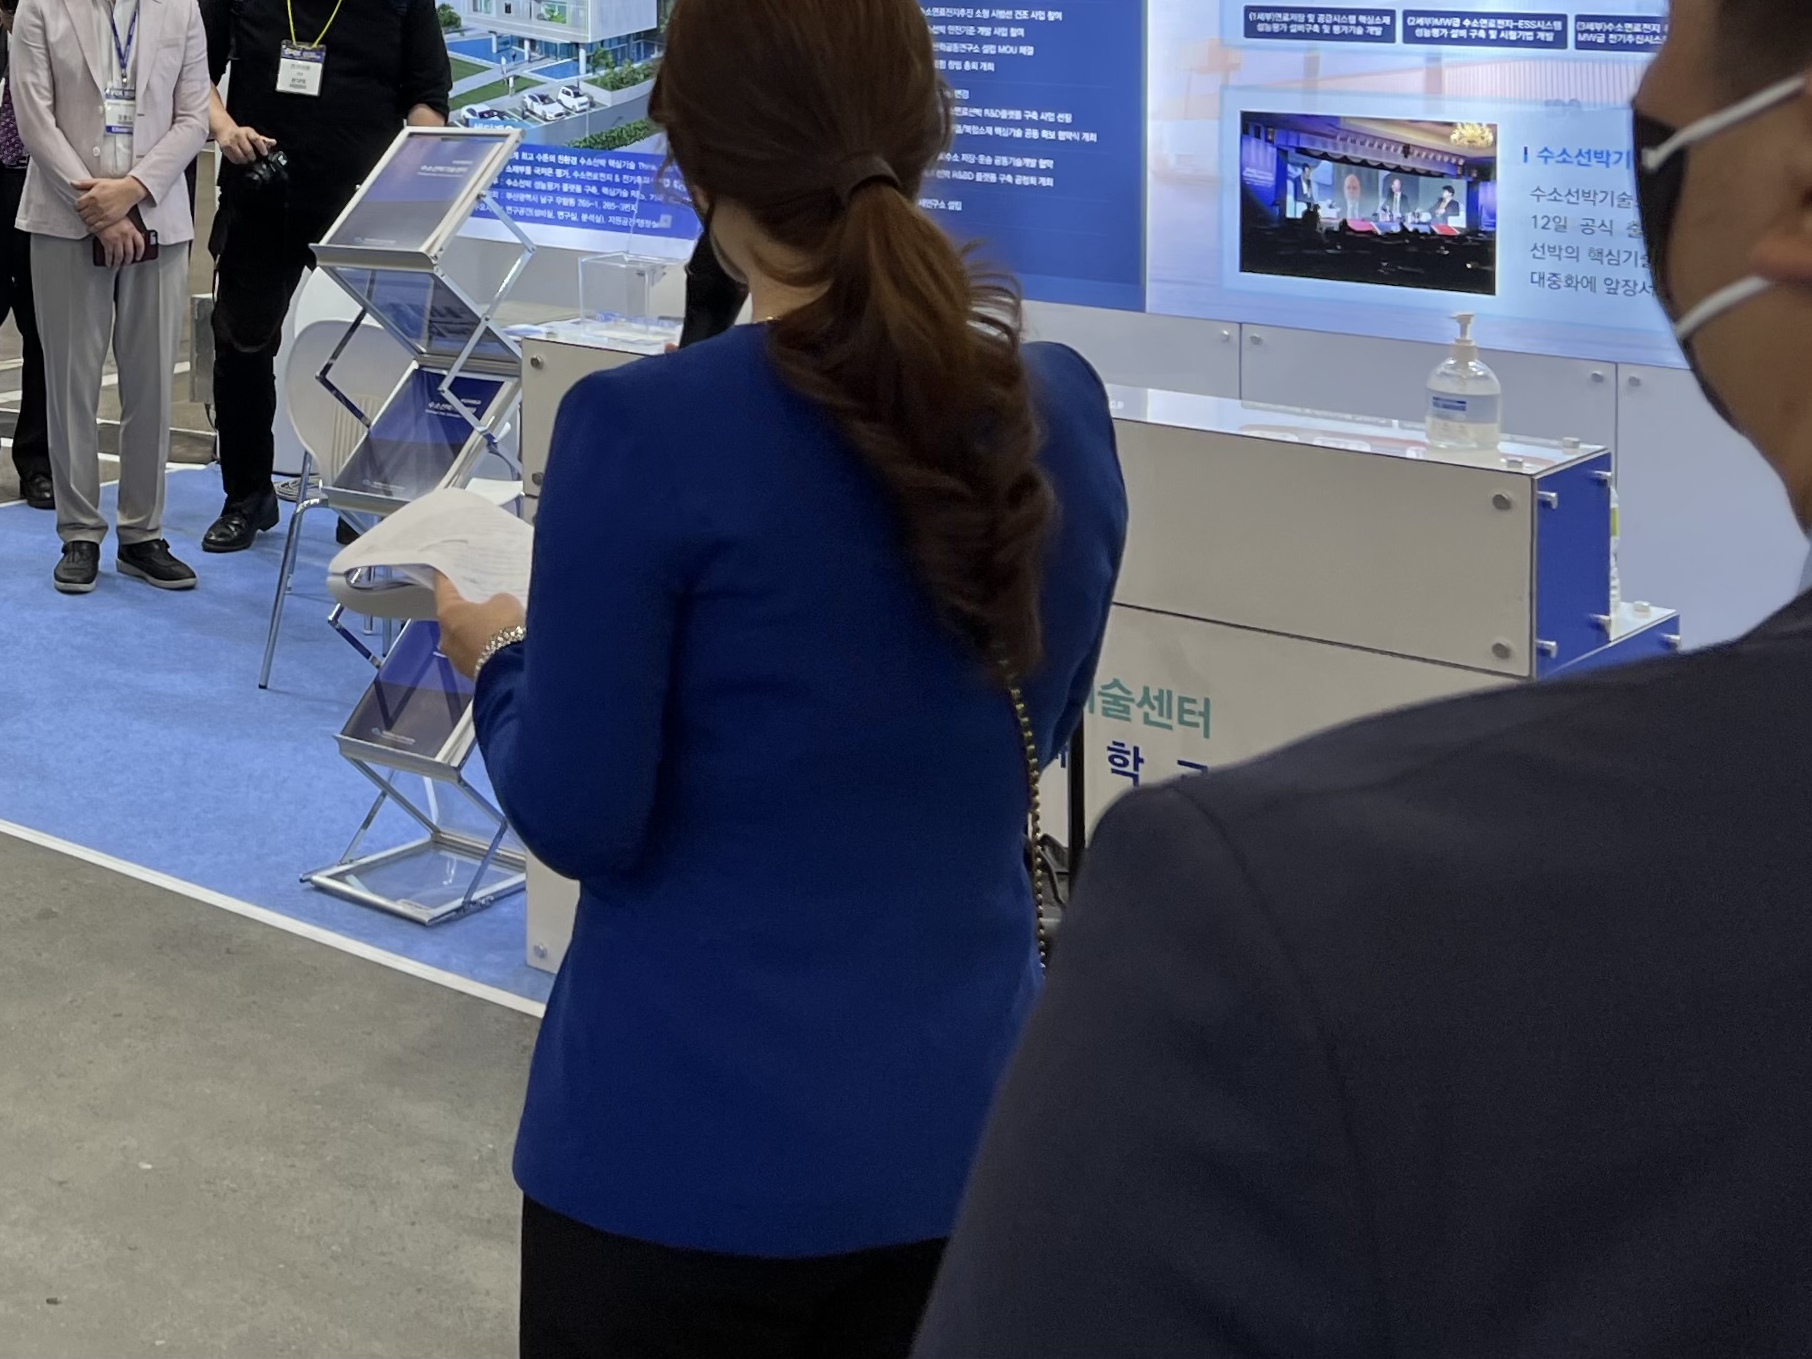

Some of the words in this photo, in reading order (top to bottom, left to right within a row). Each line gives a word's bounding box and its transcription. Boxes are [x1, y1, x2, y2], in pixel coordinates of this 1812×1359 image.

[1536, 145, 1632, 170] 수소선박기
[1529, 185, 1634, 209] 수소선박기술
[1531, 214, 1568, 233] 12일
[1579, 217, 1615, 237] 공식
[1529, 242, 1581, 263] 선박의
[1529, 270, 1598, 294] 대중화에
